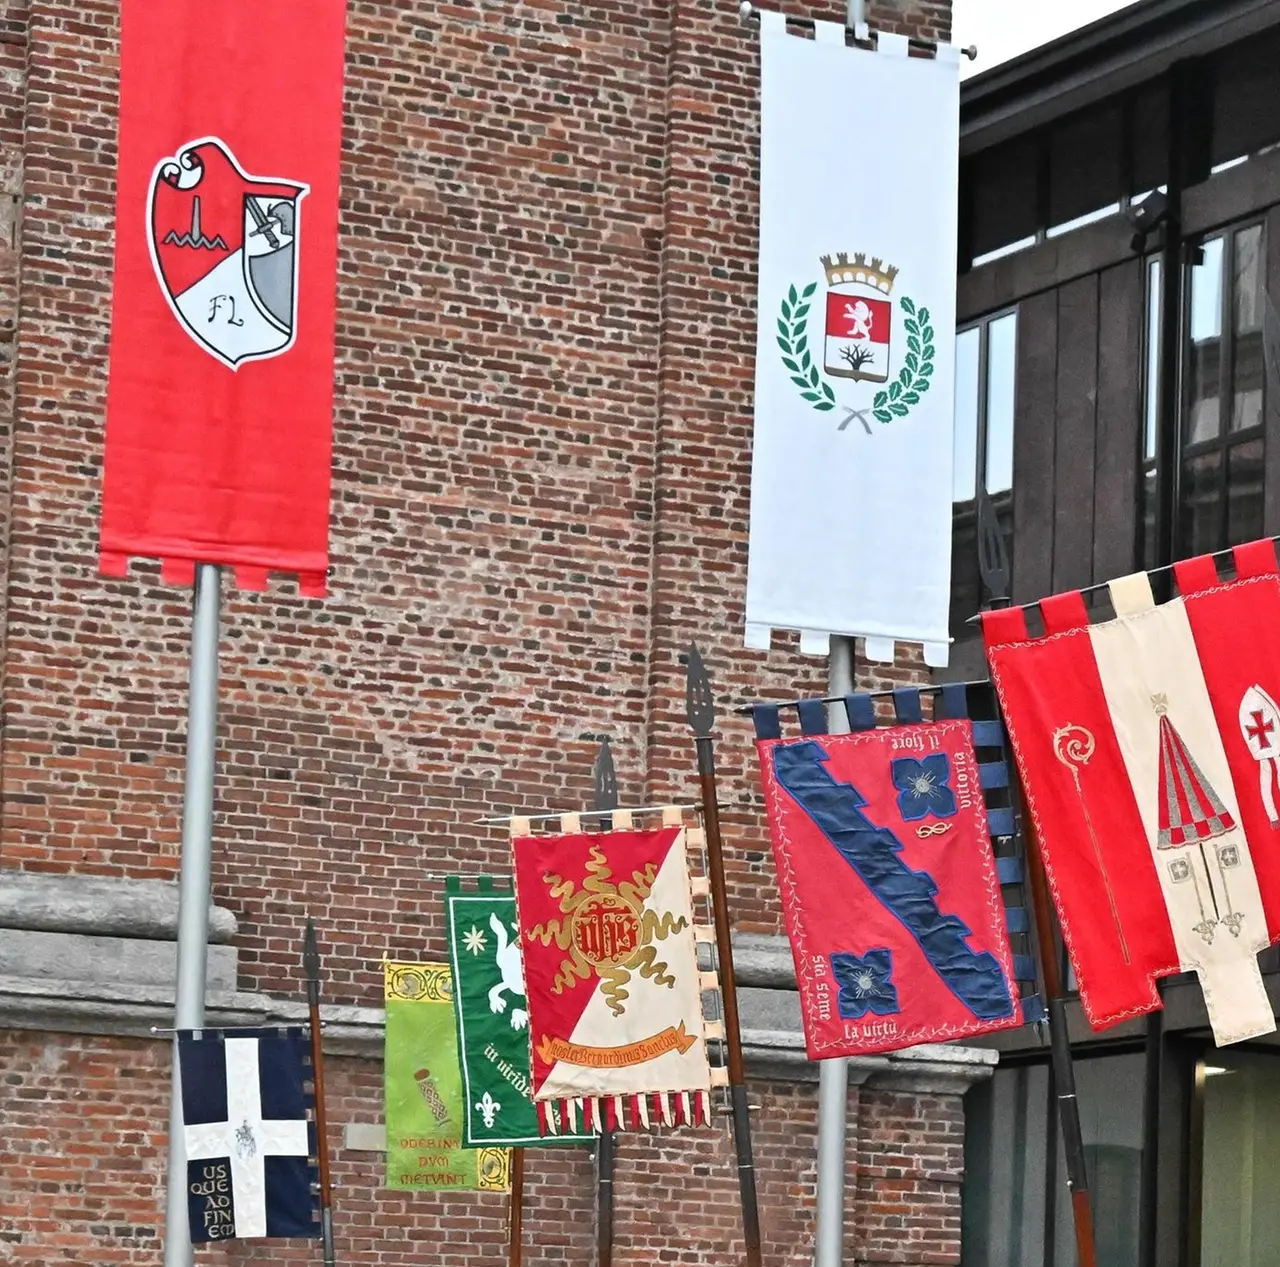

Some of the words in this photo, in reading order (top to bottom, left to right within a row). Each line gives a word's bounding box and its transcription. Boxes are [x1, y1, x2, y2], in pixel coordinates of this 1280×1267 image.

[203, 1164, 227, 1179] US
[190, 1179, 229, 1196] QUE
[203, 1209, 232, 1228] FIN
